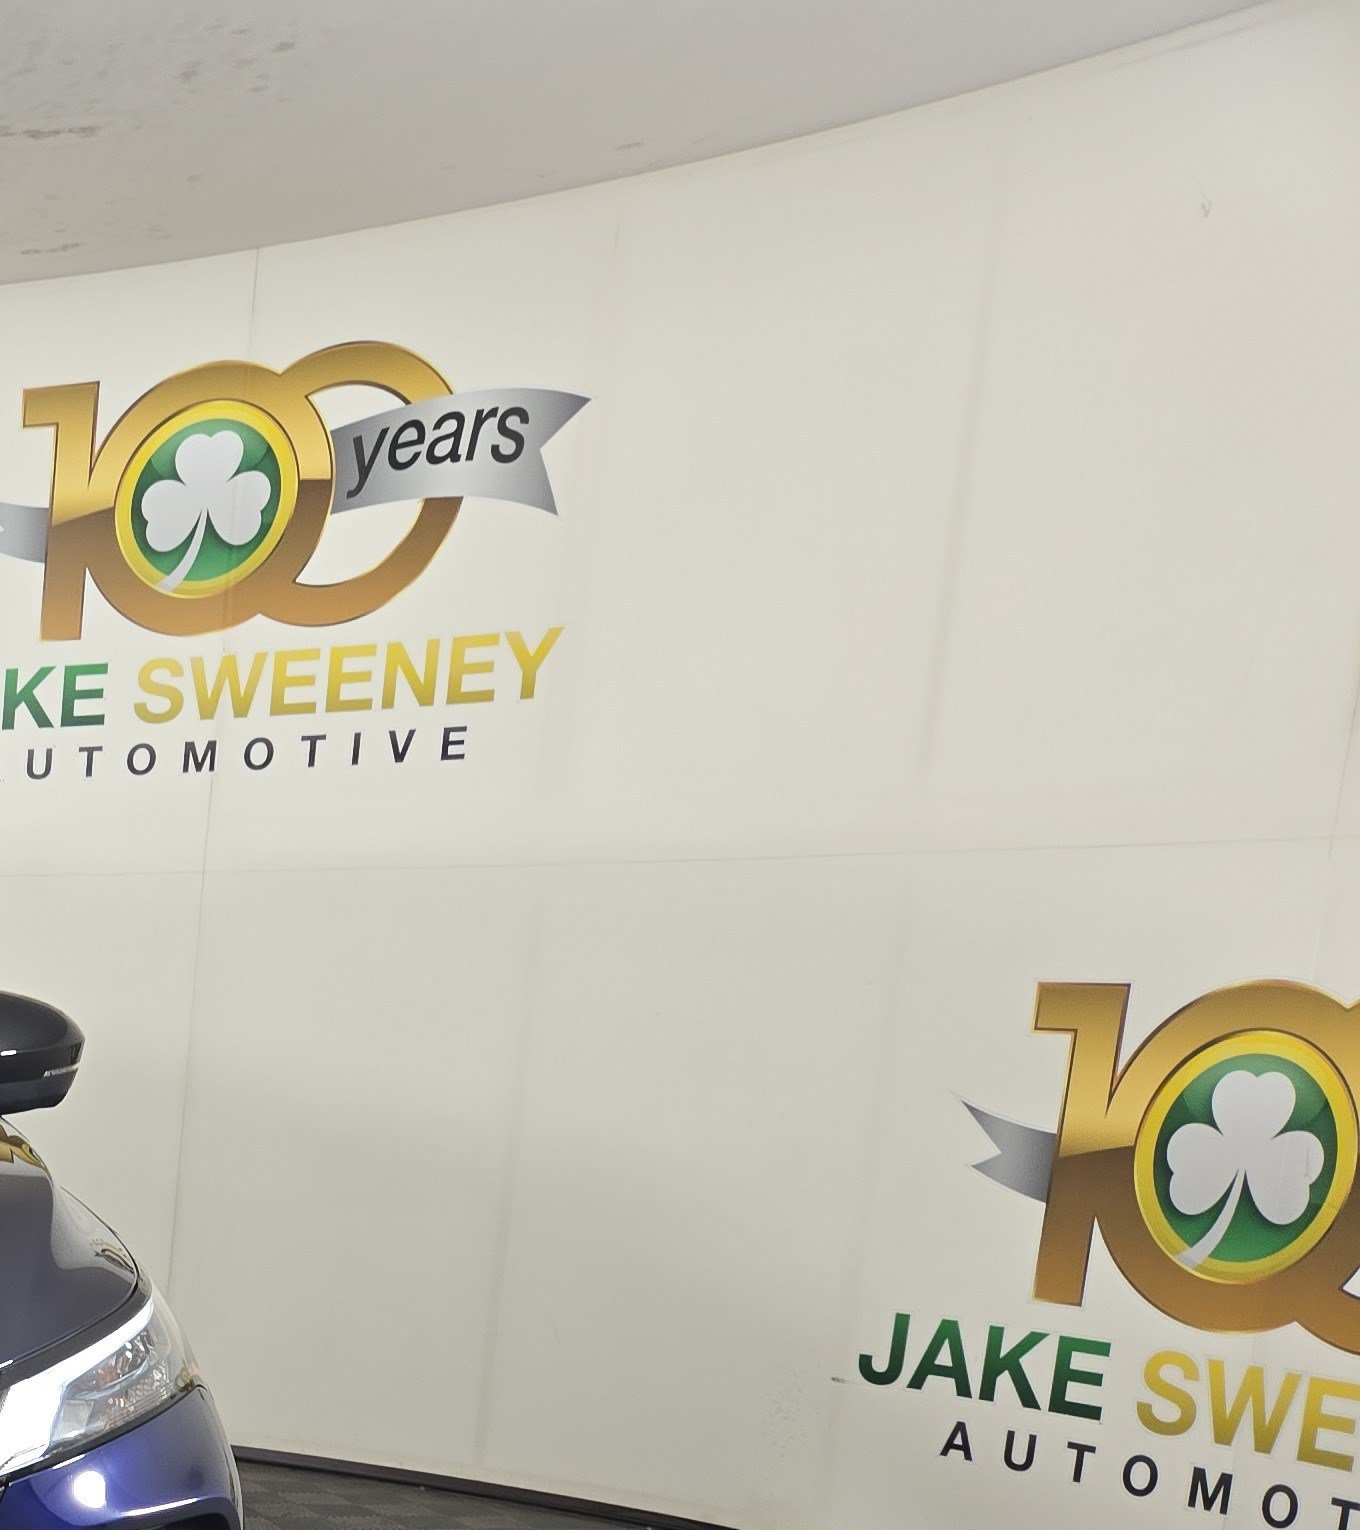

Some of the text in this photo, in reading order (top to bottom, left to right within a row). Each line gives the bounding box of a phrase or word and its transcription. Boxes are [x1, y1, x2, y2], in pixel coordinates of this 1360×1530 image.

[21, 341, 465, 642] 100
[346, 403, 530, 500] years
[134, 626, 564, 725] SWEENEY
[858, 1312, 1112, 1422] JAKE
